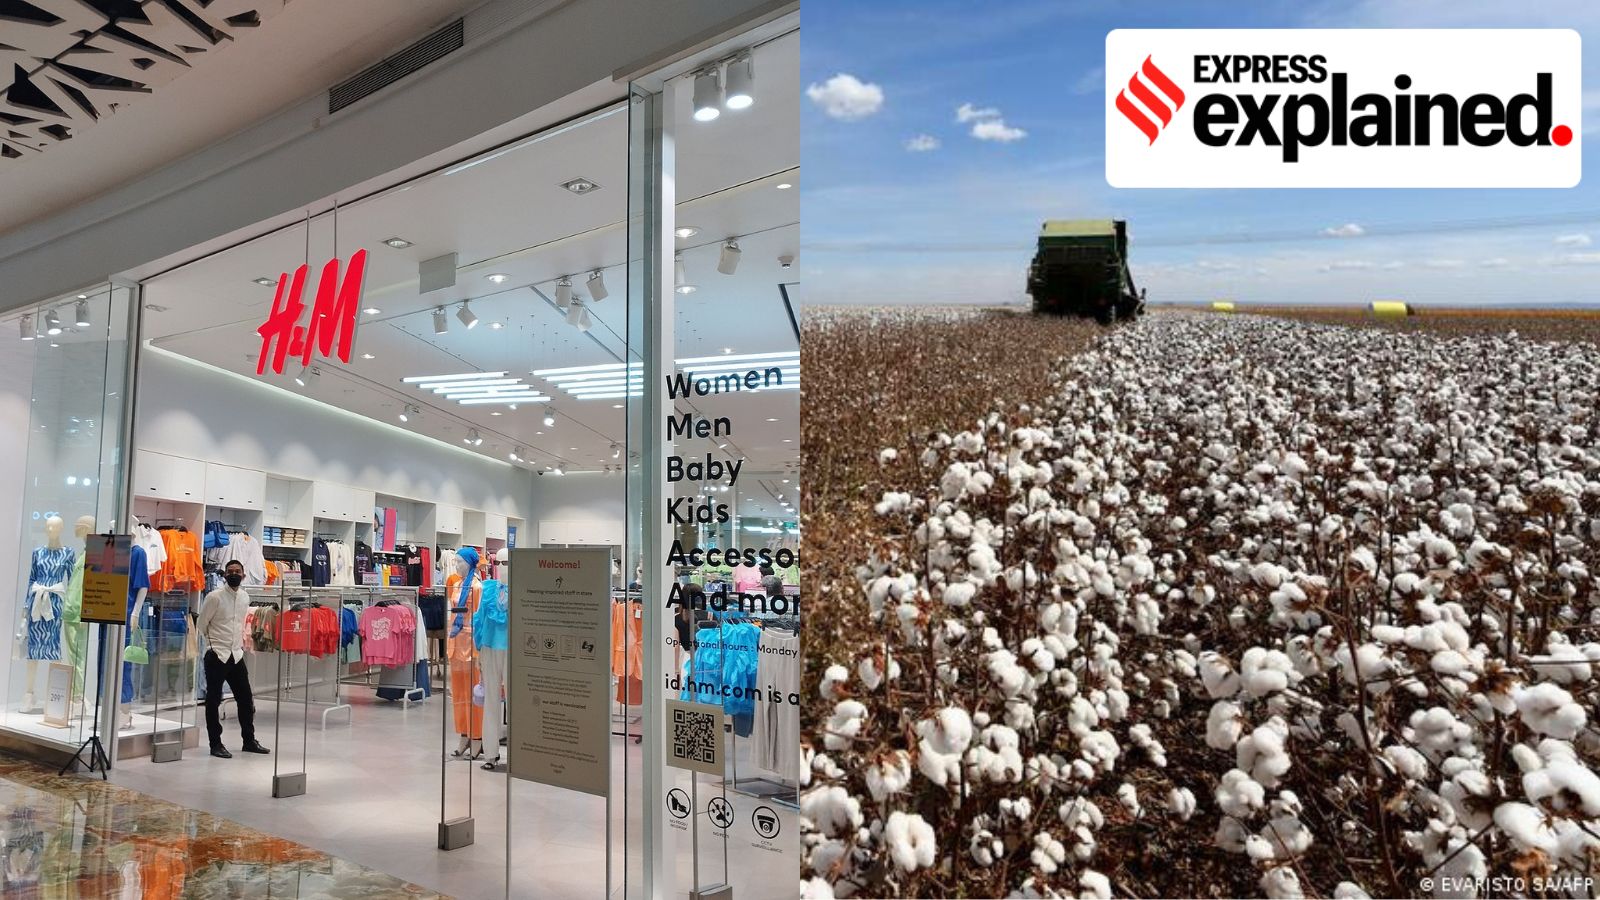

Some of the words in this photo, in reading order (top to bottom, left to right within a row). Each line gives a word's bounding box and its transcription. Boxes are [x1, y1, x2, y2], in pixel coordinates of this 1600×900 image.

[256, 248, 367, 375] H&M
[666, 366, 783, 400] Women
[666, 413, 732, 441] Men
[666, 452, 743, 486] Baby
[666, 495, 730, 525] Kids
[538, 559, 581, 569] Welcome!
[665, 582, 728, 611] And
[738, 593, 800, 616] mor
[665, 636, 720, 650] Opational
[722, 640, 748, 652] hours
[757, 644, 798, 659] Monday
[665, 673, 762, 701] id.hm.com
[768, 685, 782, 704] is
